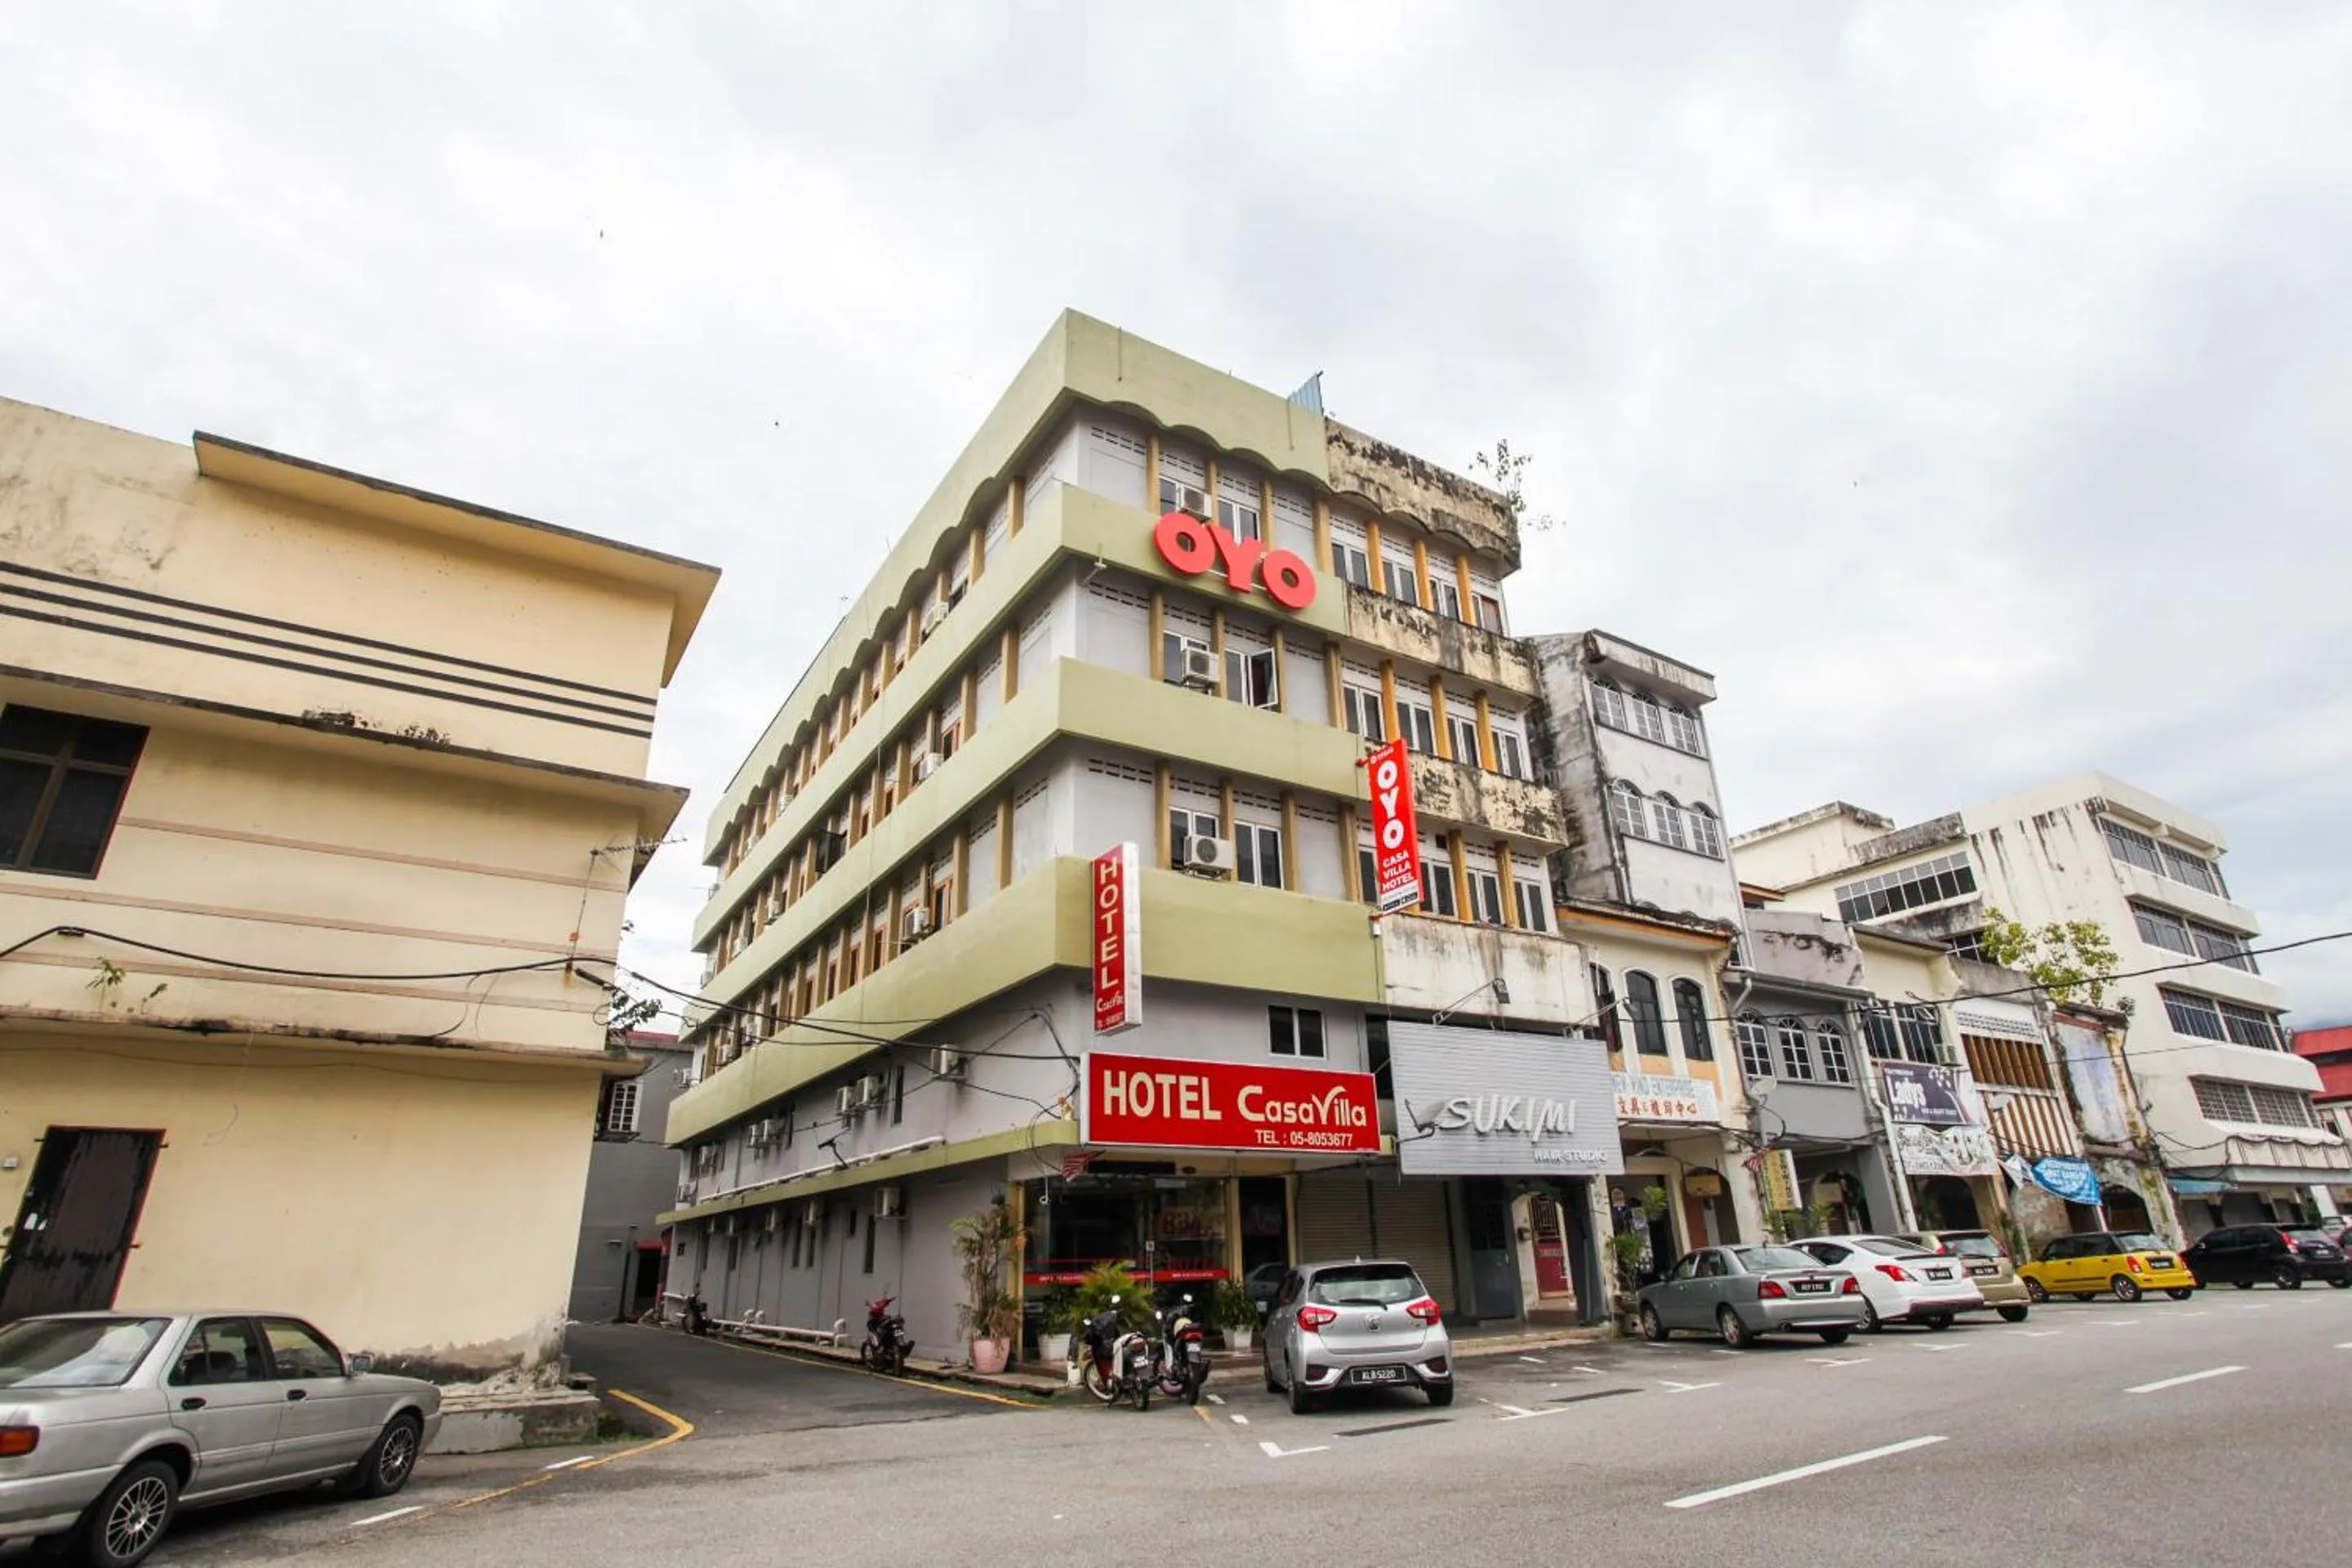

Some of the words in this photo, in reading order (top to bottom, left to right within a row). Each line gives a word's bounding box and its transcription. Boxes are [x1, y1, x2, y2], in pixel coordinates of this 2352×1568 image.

[1154, 511, 1316, 608] OYO
[1377, 760, 1404, 849] OYO
[1383, 849, 1410, 868] CASA
[1383, 861, 1411, 880] VILLA
[1383, 872, 1414, 892] HOTEL
[1099, 856, 1118, 990] HOTEL
[1102, 1069, 1222, 1121] HOTEL
[1437, 1093, 1578, 1143] SUKIMI
[1254, 1129, 1280, 1144] TEL
[1290, 1131, 1353, 1147] 05-8053677
[1562, 1149, 1608, 1164] STUDIO
